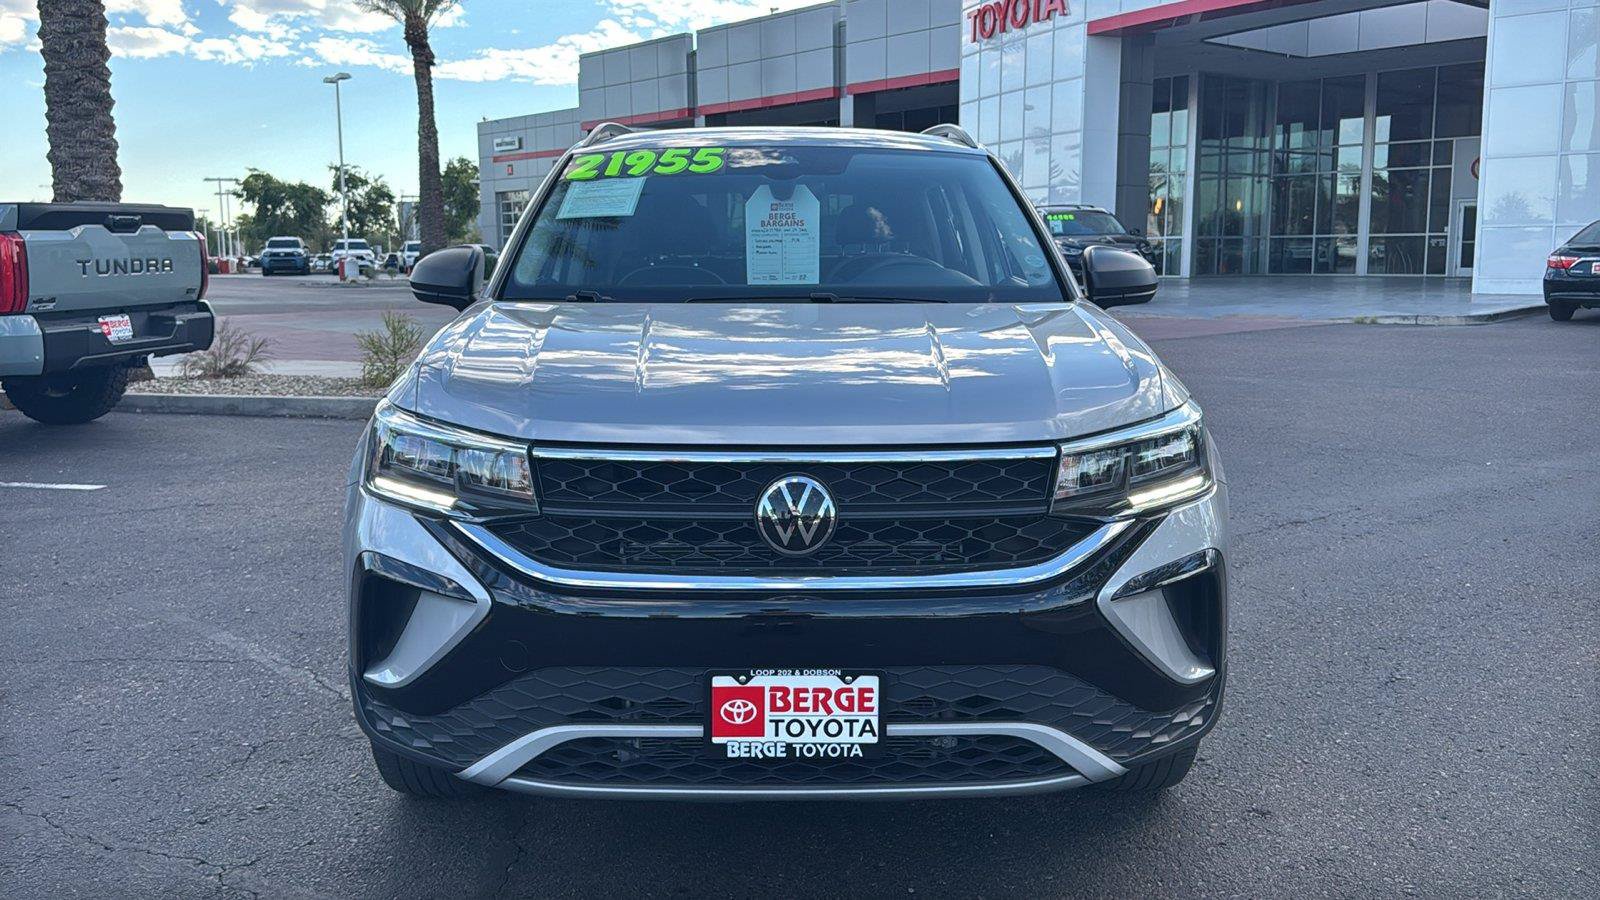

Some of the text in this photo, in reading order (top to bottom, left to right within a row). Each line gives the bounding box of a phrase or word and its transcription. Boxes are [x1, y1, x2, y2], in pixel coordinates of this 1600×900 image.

[565, 147, 726, 181] 21955
[760, 219, 805, 228] BARGAINS
[768, 212, 797, 220] BERGE
[76, 258, 174, 278] TUNDRA
[109, 319, 130, 328] BERGE
[769, 686, 875, 716] BERGE
[769, 718, 877, 738] TOYOTA
[726, 741, 864, 759] BERGE TOYOTA
